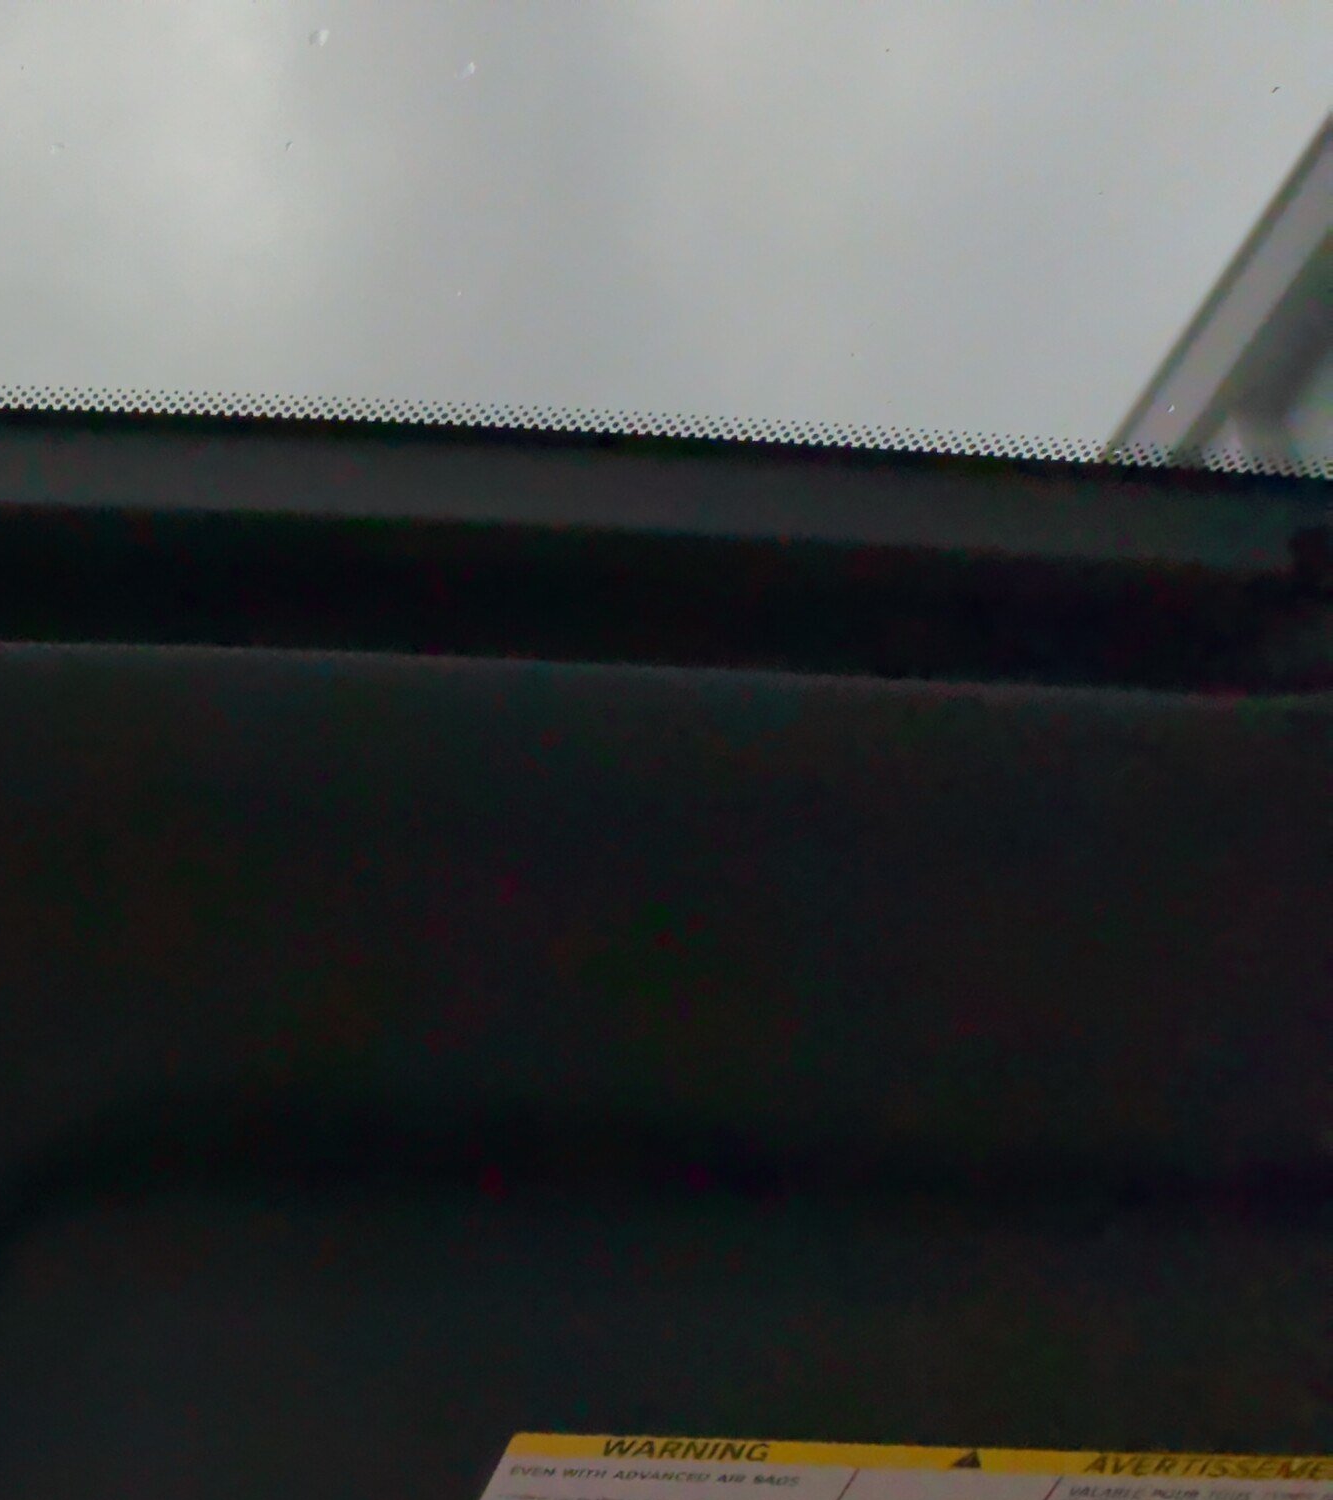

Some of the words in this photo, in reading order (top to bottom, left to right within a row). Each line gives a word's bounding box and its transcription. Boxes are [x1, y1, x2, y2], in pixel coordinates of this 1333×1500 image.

[603, 1439, 770, 1461] WARNING
[510, 1465, 556, 1477] EVEN
[562, 1467, 608, 1479] WITH
[612, 1469, 710, 1483] ADVANCED
[716, 1473, 747, 1484] AIR
